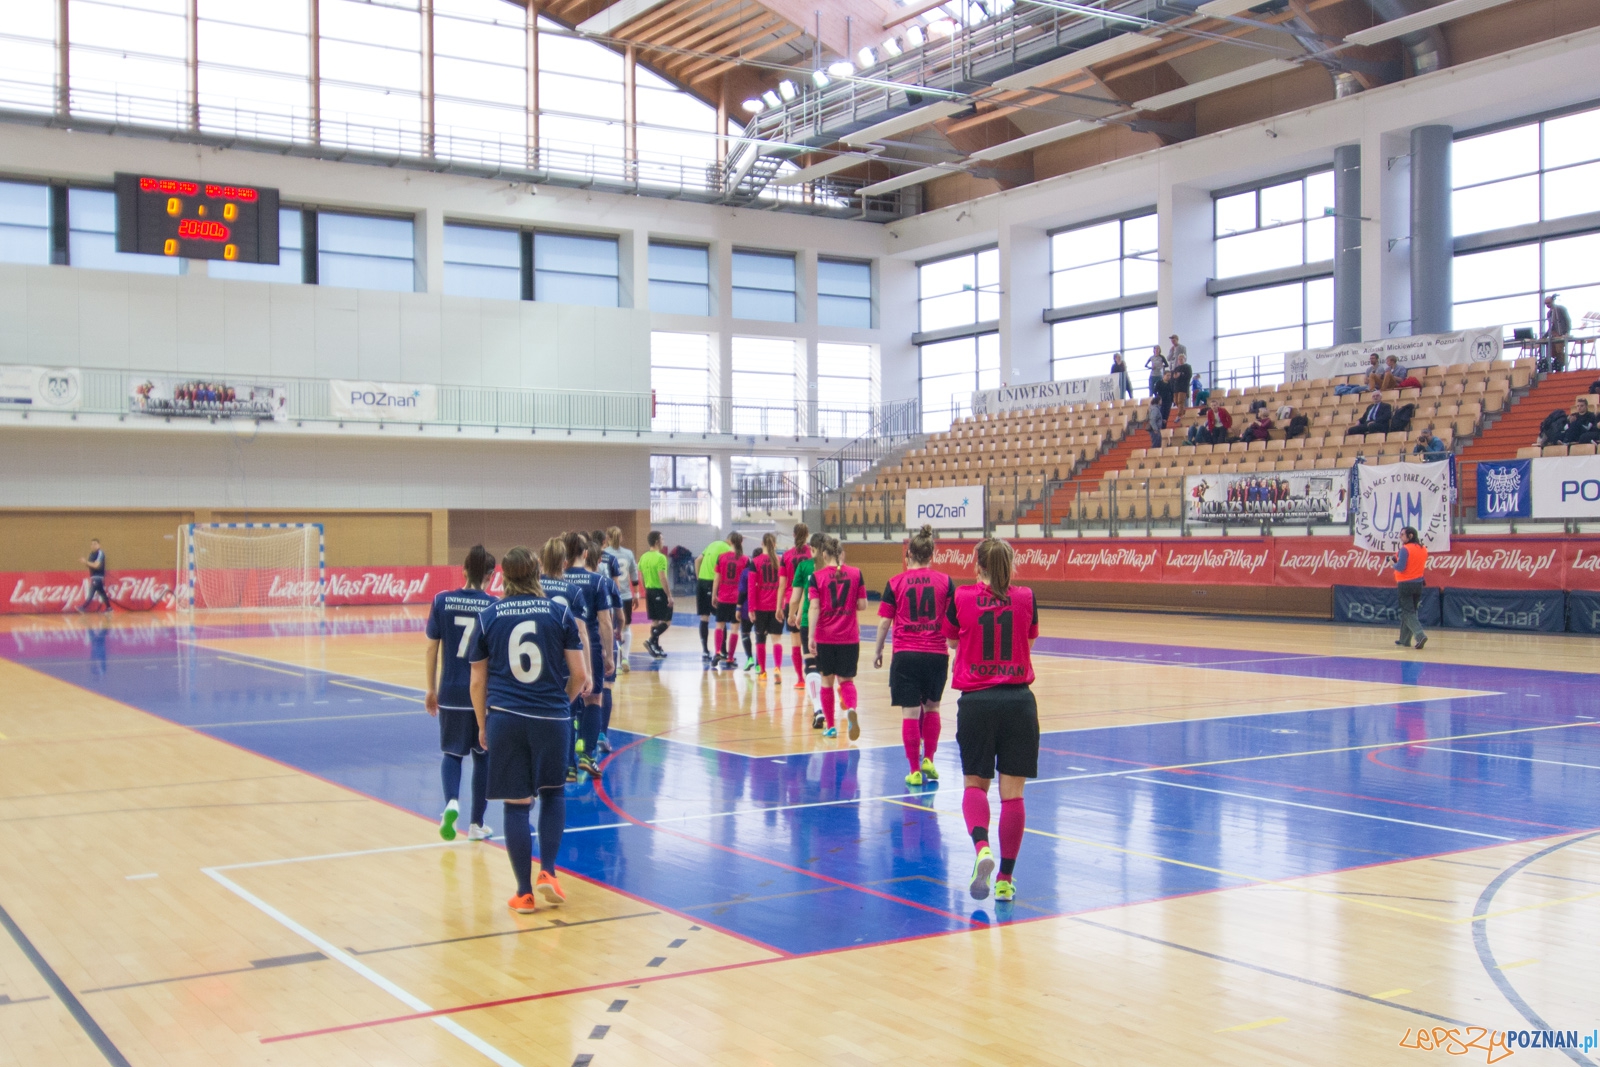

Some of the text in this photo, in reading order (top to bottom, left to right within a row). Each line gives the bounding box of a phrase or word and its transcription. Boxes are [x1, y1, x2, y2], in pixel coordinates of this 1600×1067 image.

[167, 198, 178, 214] 0
[223, 203, 235, 220] 0
[164, 239, 235, 260] 0 0
[1387, 342, 1424, 351] Mickiewicza
[350, 391, 416, 407] POZnan
[997, 380, 1090, 402] UNIWERSYTET
[1390, 474, 1402, 483] TO
[917, 503, 966, 518] POZnan
[1201, 501, 1219, 514] KU
[1221, 500, 1243, 513] AZS
[1246, 500, 1274, 513] UAM
[1373, 491, 1422, 532] UAM
[1166, 548, 1269, 574] LaczyNasPilka.pl
[1424, 548, 1557, 579] aczyNasPilka.pl
[906, 577, 931, 585] UAM
[445, 596, 490, 606] UNIWERSYTET
[828, 579, 851, 609] 17
[906, 586, 937, 622] 14
[976, 596, 1013, 607] UAM
[495, 600, 551, 610] UNIWERSYTET
[496, 606, 551, 617] JAGIELLOŃSKI
[1462, 605, 1540, 627] POZnan
[454, 616, 476, 658] 7
[978, 610, 1013, 661] 11
[508, 620, 543, 684] 6
